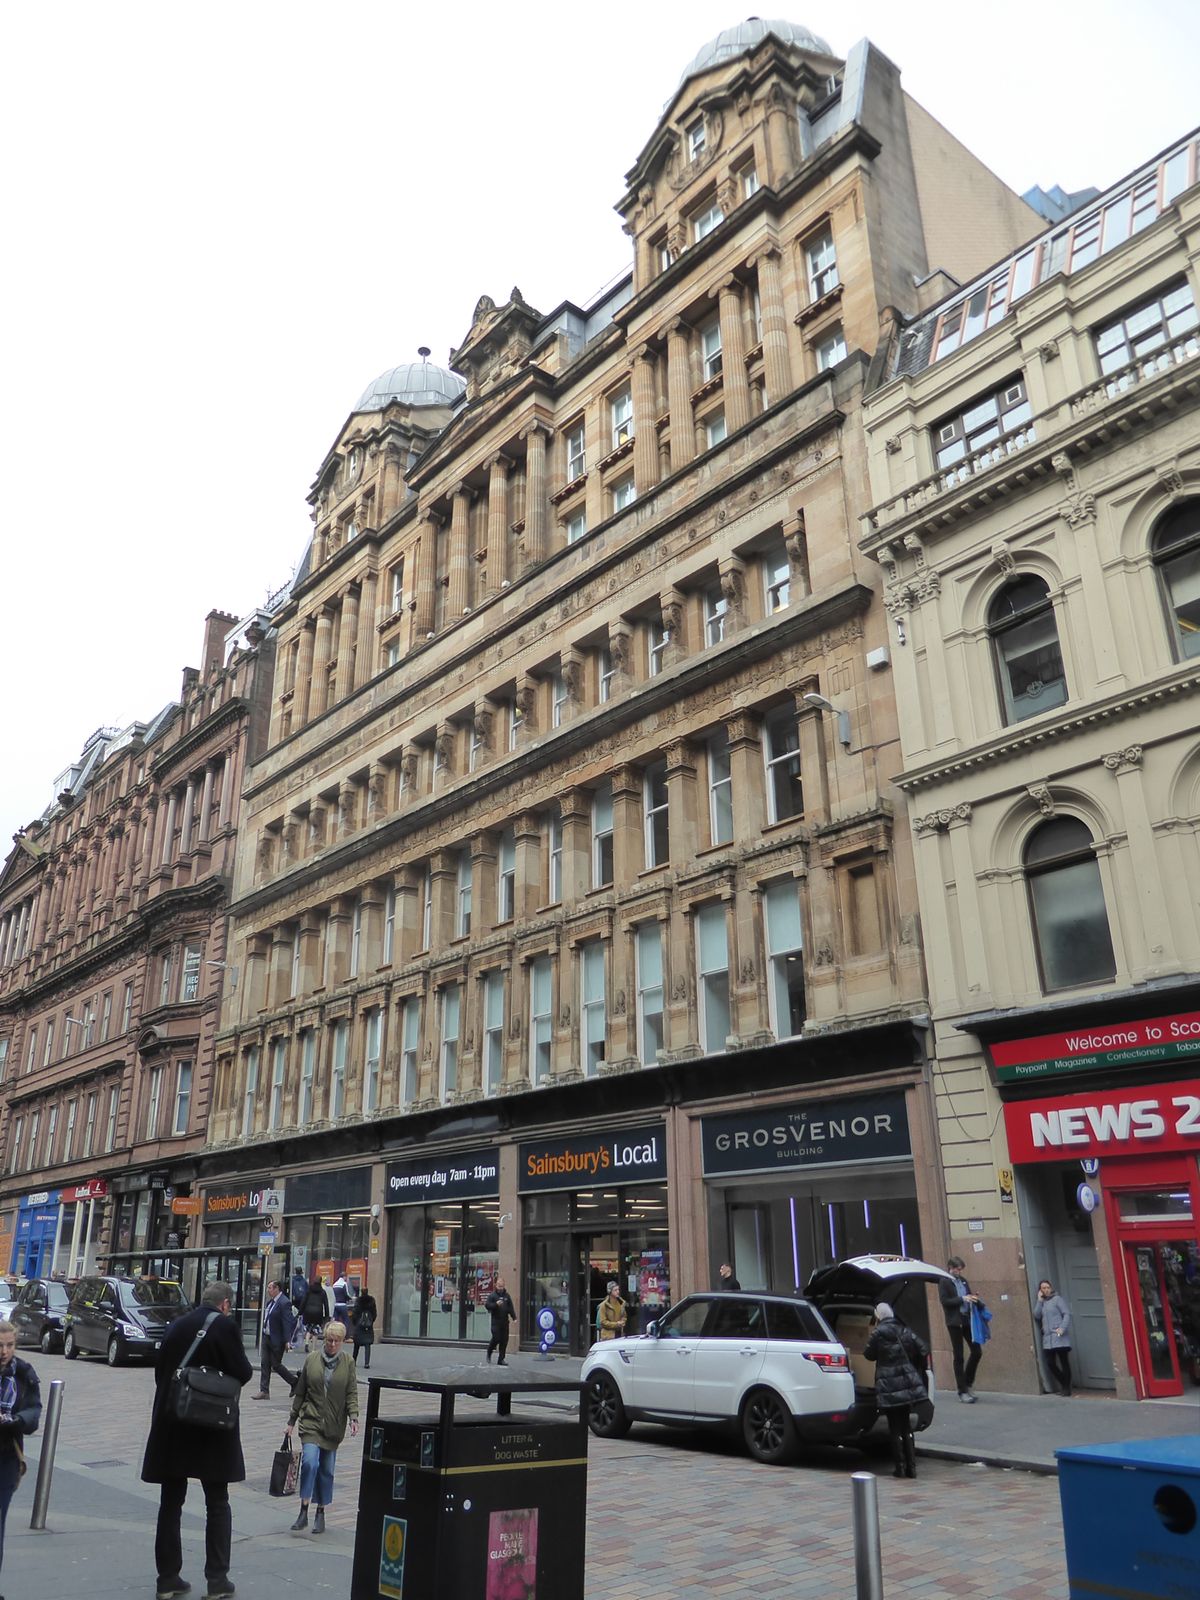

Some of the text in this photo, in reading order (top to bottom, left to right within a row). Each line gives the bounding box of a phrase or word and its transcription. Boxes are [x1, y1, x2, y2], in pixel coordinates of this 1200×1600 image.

[1065, 1031, 1138, 1052] Welcome
[1145, 1026, 1162, 1040] to
[1015, 1063, 1047, 1074] Paypoint
[1054, 1056, 1097, 1069] Magazines
[1106, 1047, 1166, 1062] Confectionery
[788, 1112, 808, 1122] THE
[1030, 1100, 1165, 1148] NEWS
[715, 1114, 893, 1151] GROSVENOR
[527, 1137, 657, 1176] Sainsbury's Local
[776, 1146, 824, 1158] BUILDING
[390, 1176, 409, 1190] Open
[410, 1173, 431, 1187] every
[432, 1170, 447, 1186] day
[449, 1168, 467, 1181] 7am
[473, 1165, 496, 1181] 11pm
[207, 1192, 247, 1212] Sainsbury's
[501, 1434, 526, 1444] LITTER
[495, 1449, 539, 1460] DOG WASTE
